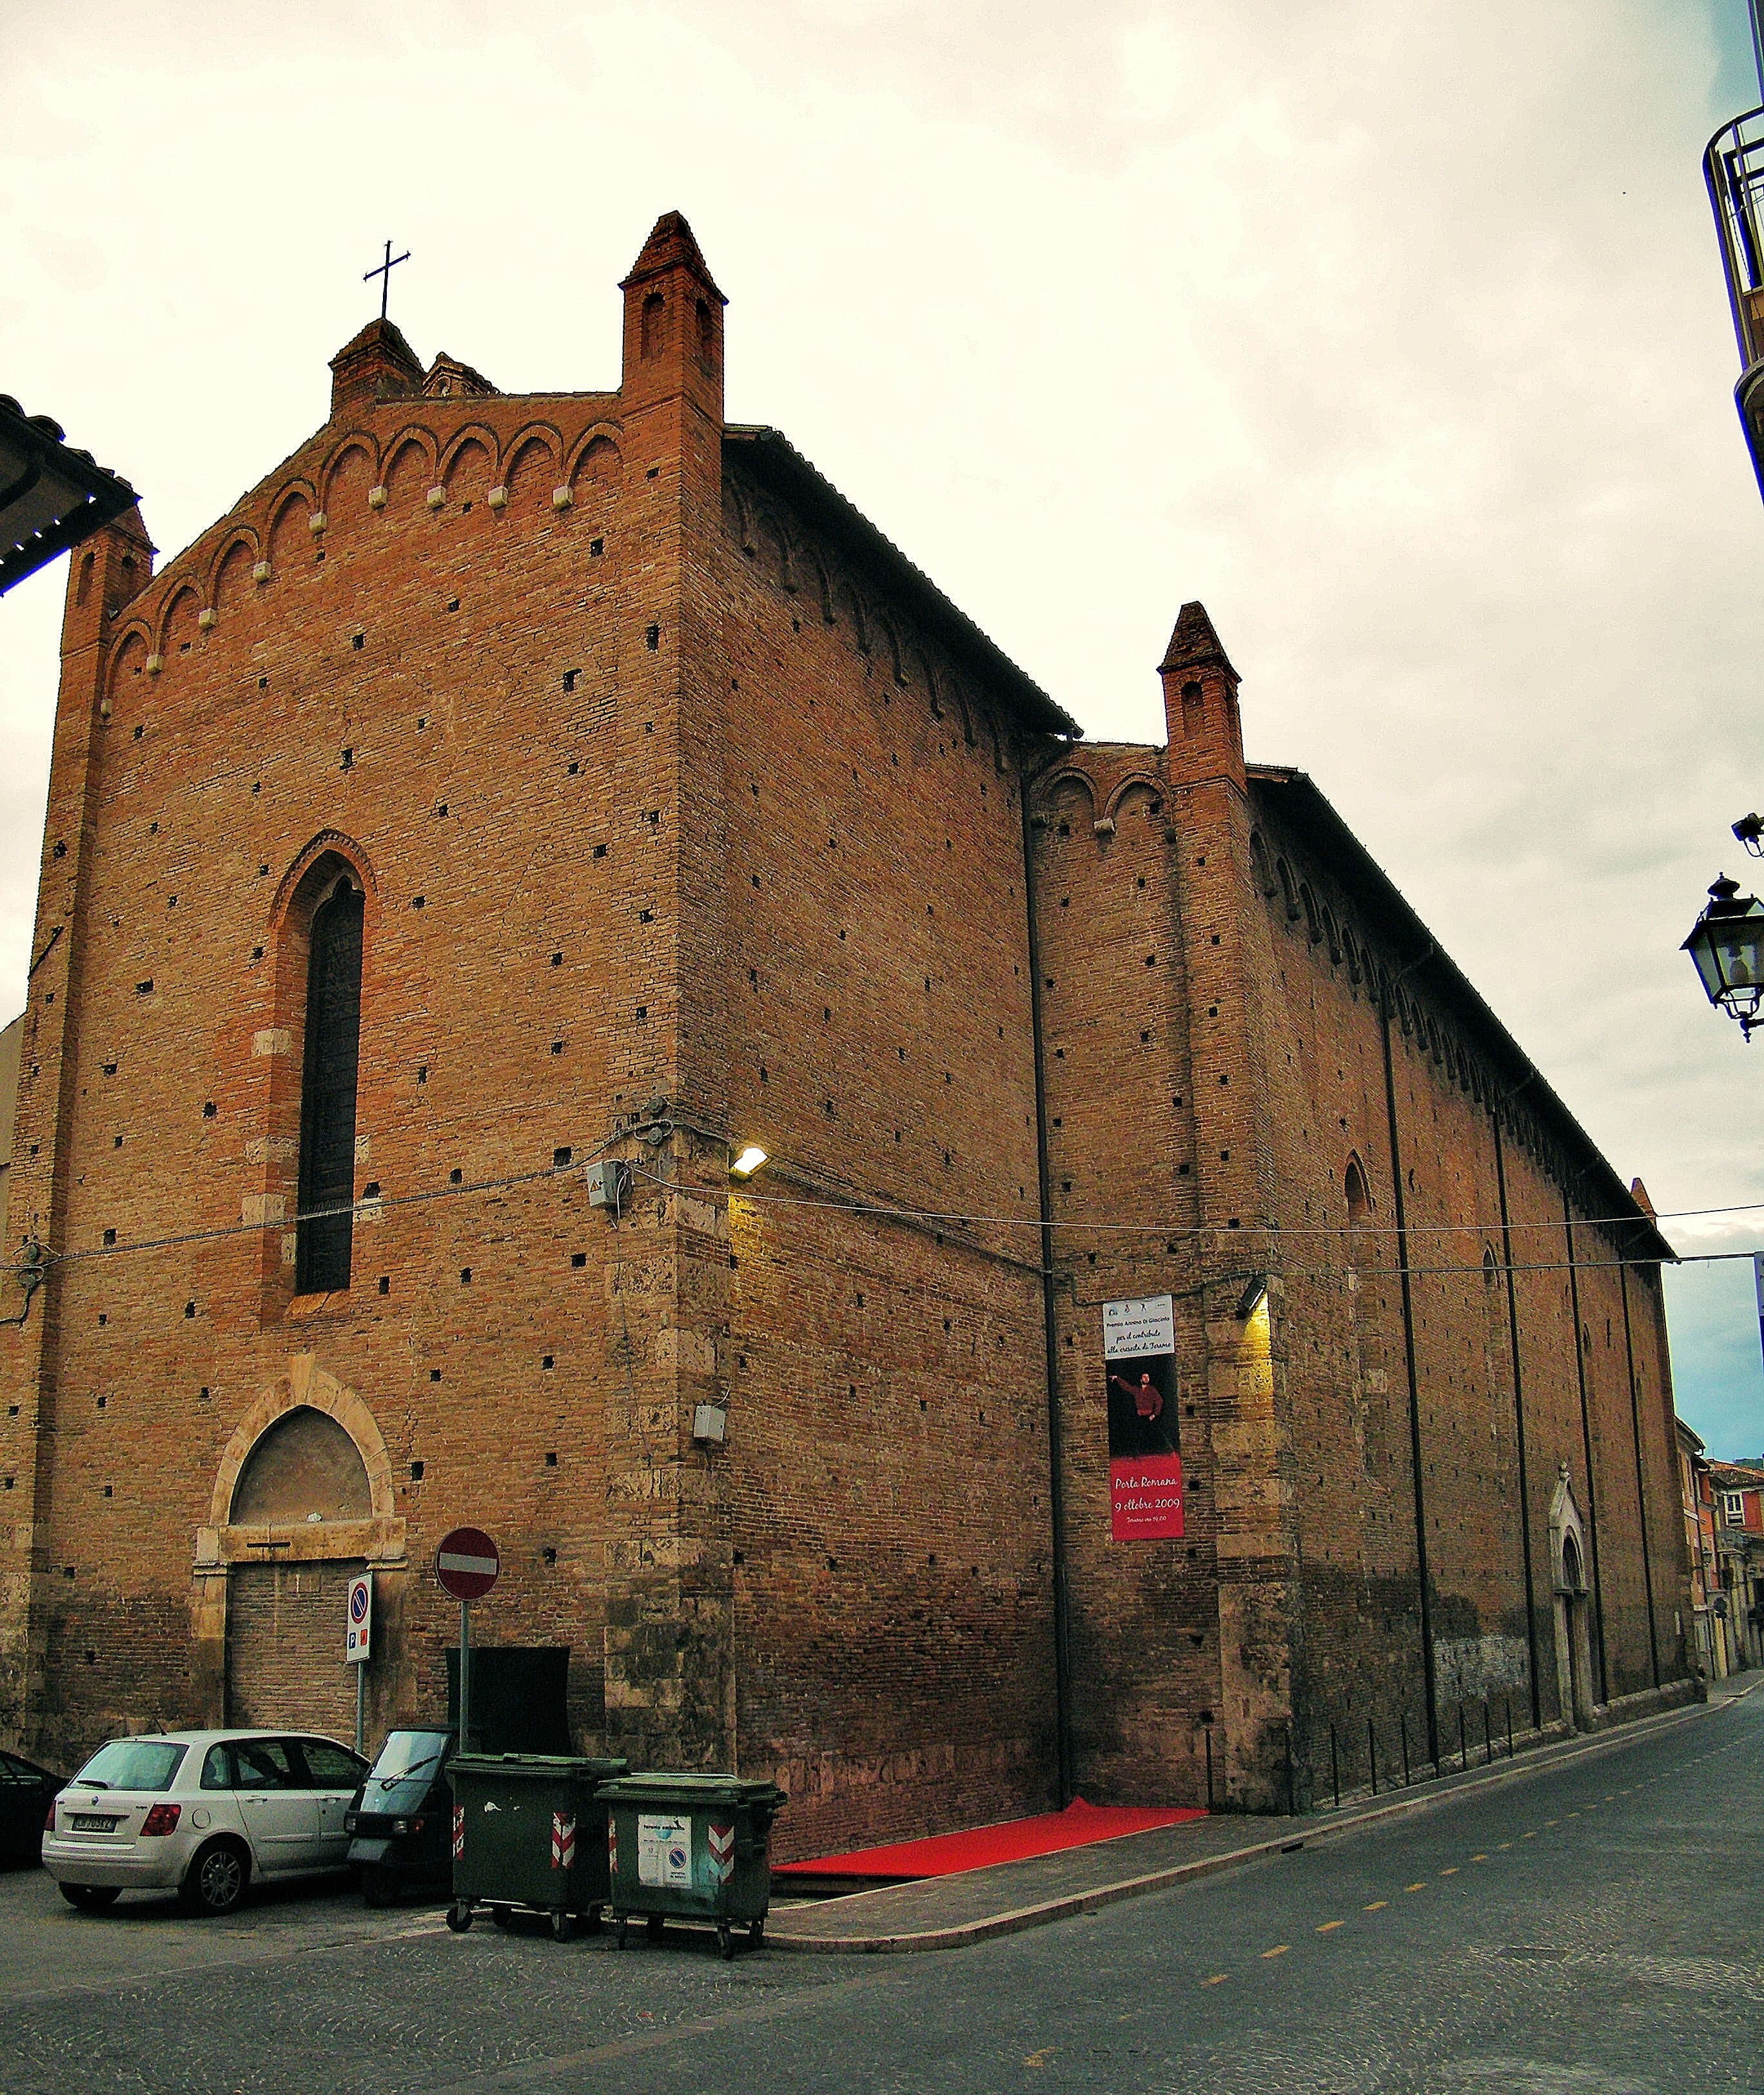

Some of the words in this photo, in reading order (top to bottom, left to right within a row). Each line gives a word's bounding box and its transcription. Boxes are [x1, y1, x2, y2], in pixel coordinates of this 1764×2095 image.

[1115, 1476, 1140, 1490] Porta
[1141, 1476, 1179, 1488] Romana
[1115, 1502, 1122, 1512] 9
[1124, 1497, 1153, 1510] ottobre
[1155, 1498, 1181, 1509] 2009
